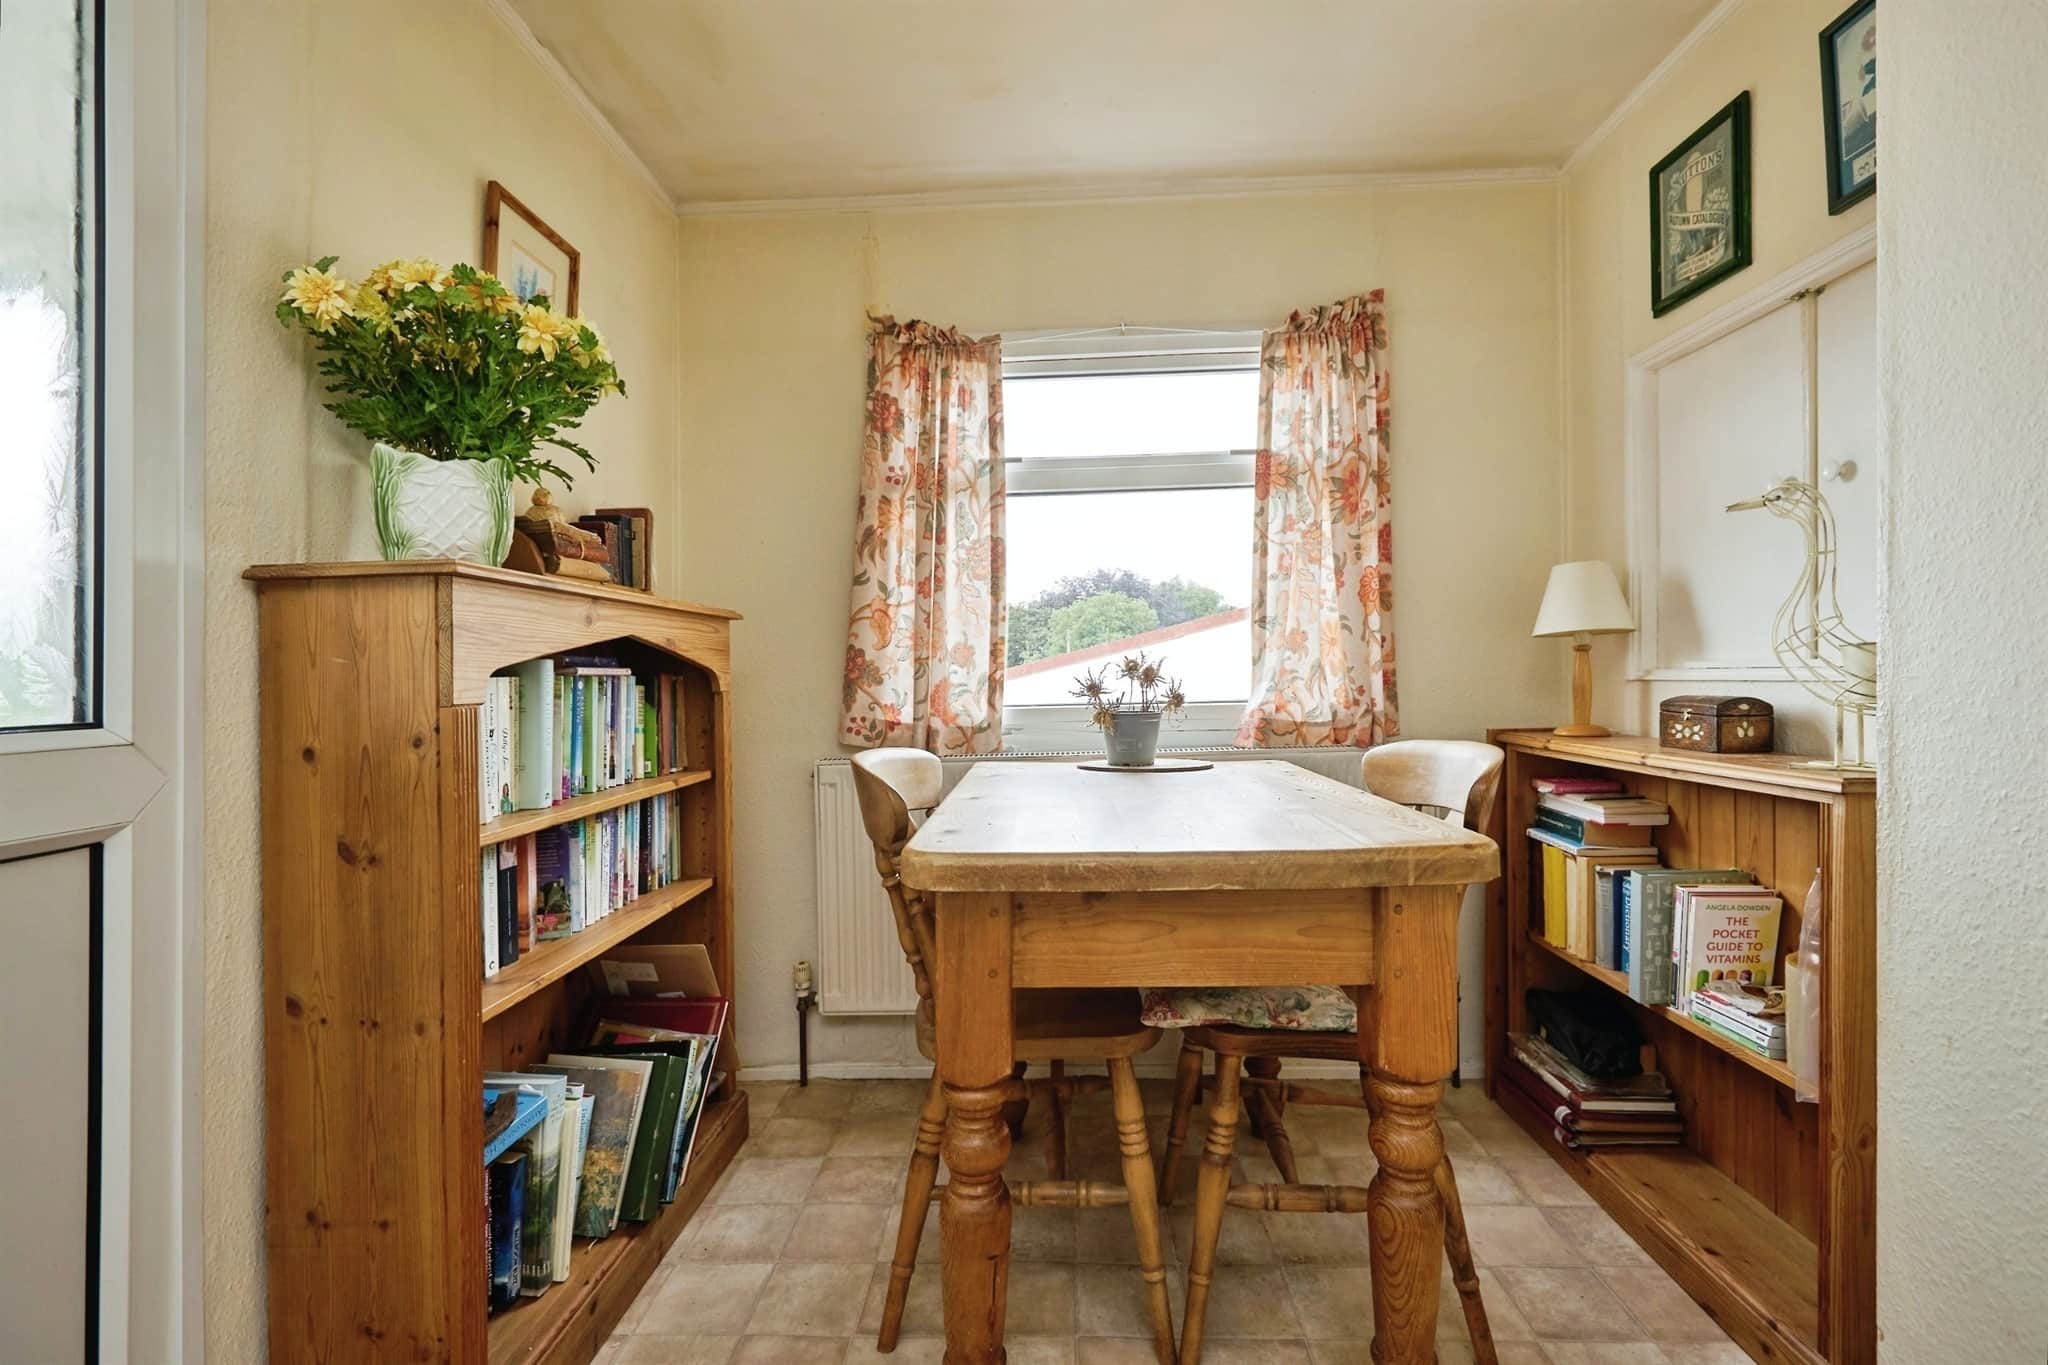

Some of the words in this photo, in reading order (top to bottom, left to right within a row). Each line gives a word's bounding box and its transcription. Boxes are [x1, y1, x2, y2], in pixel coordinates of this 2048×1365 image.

[1691, 213, 1725, 225] CATALOGUE
[1737, 904, 1771, 912] DOWDEN
[1725, 916, 1750, 926] THE
[1712, 929, 1760, 939] POCKET
[1706, 942, 1744, 952] GUIDE
[1747, 942, 1764, 951] TO
[1706, 954, 1761, 964] VITAMINS
